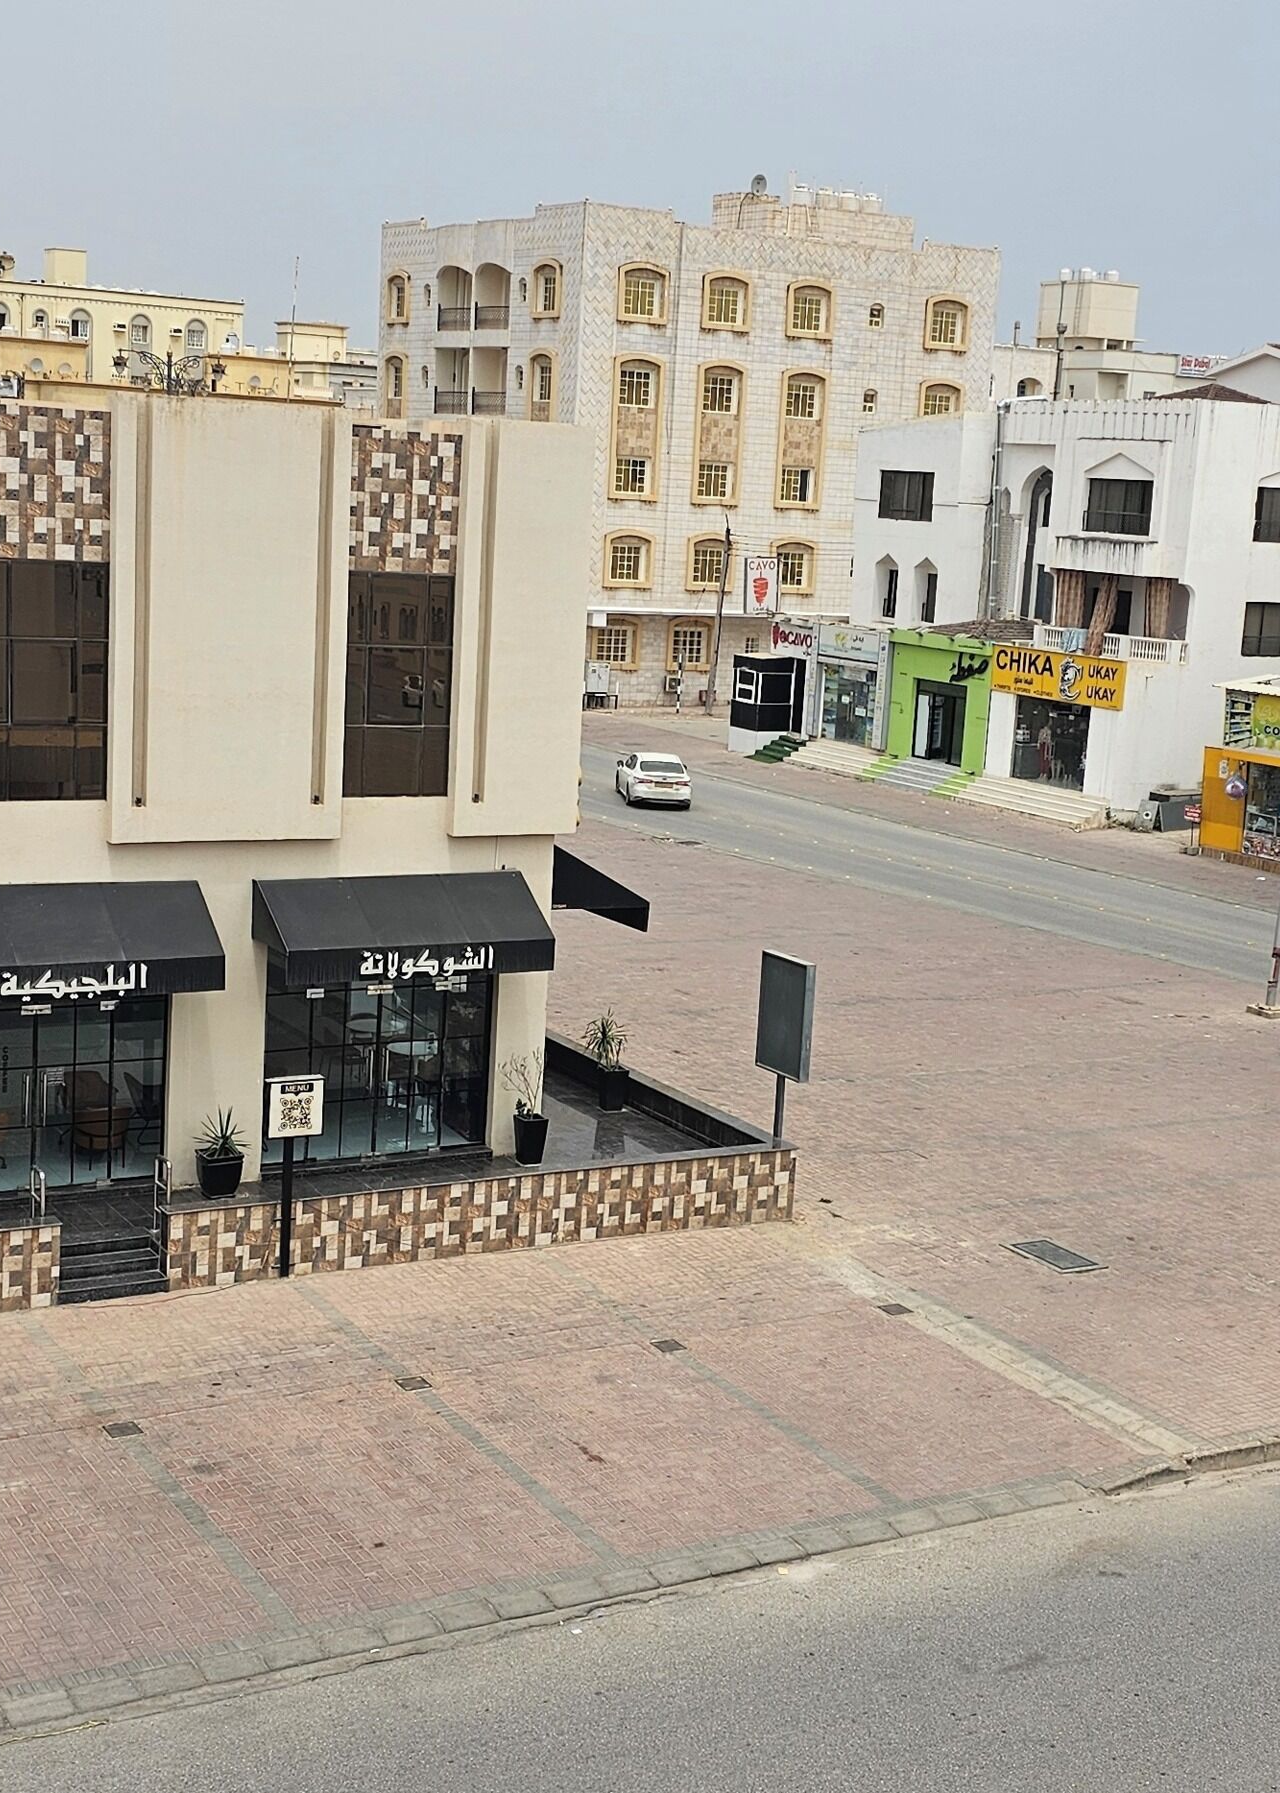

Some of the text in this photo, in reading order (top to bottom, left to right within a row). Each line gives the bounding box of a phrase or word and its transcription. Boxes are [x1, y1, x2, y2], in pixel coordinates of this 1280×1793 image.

[748, 560, 776, 571] CAVO
[996, 649, 1054, 677] CHIKA
[1088, 665, 1118, 681] UKAY
[1086, 685, 1116, 702] UKAY
[359, 943, 494, 980] الشوكولاتة
[0, 961, 148, 1002] البلجيكية
[284, 1084, 310, 1092] MENU
